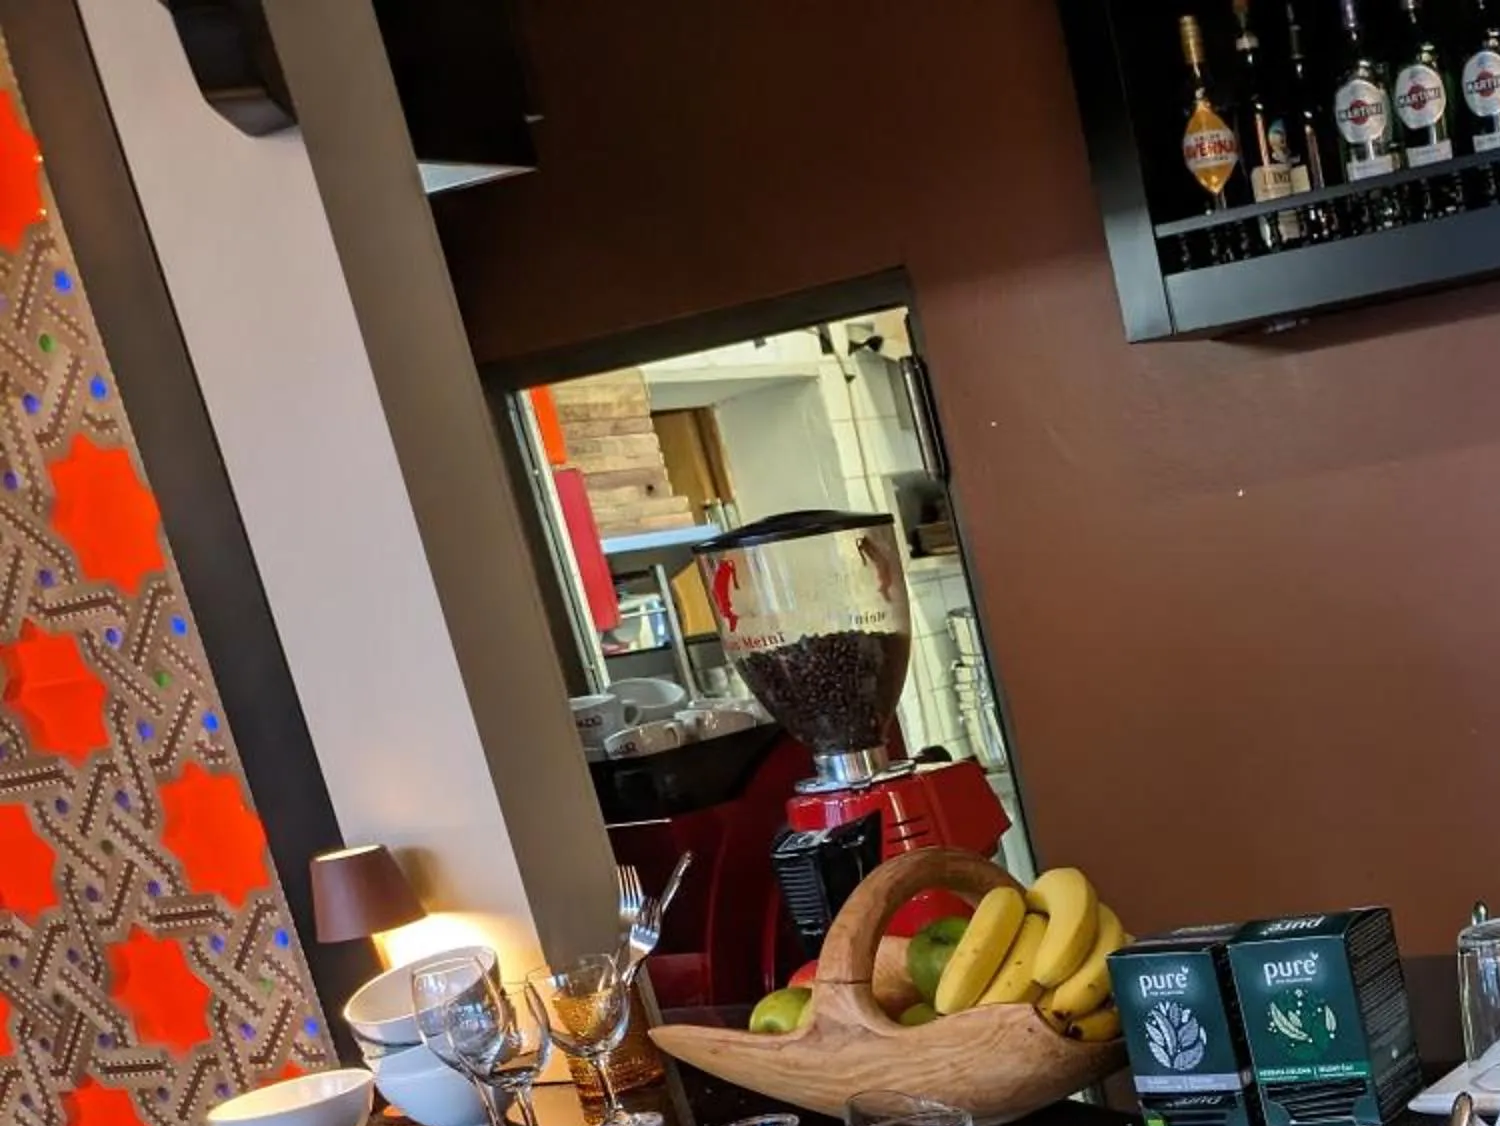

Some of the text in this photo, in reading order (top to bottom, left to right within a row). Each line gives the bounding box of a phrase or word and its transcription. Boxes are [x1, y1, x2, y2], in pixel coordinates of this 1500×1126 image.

[1398, 87, 1442, 108] MARTINI
[1338, 103, 1383, 122] MARTINI
[1263, 958, 1317, 986] pure
[1139, 972, 1187, 998] pure
